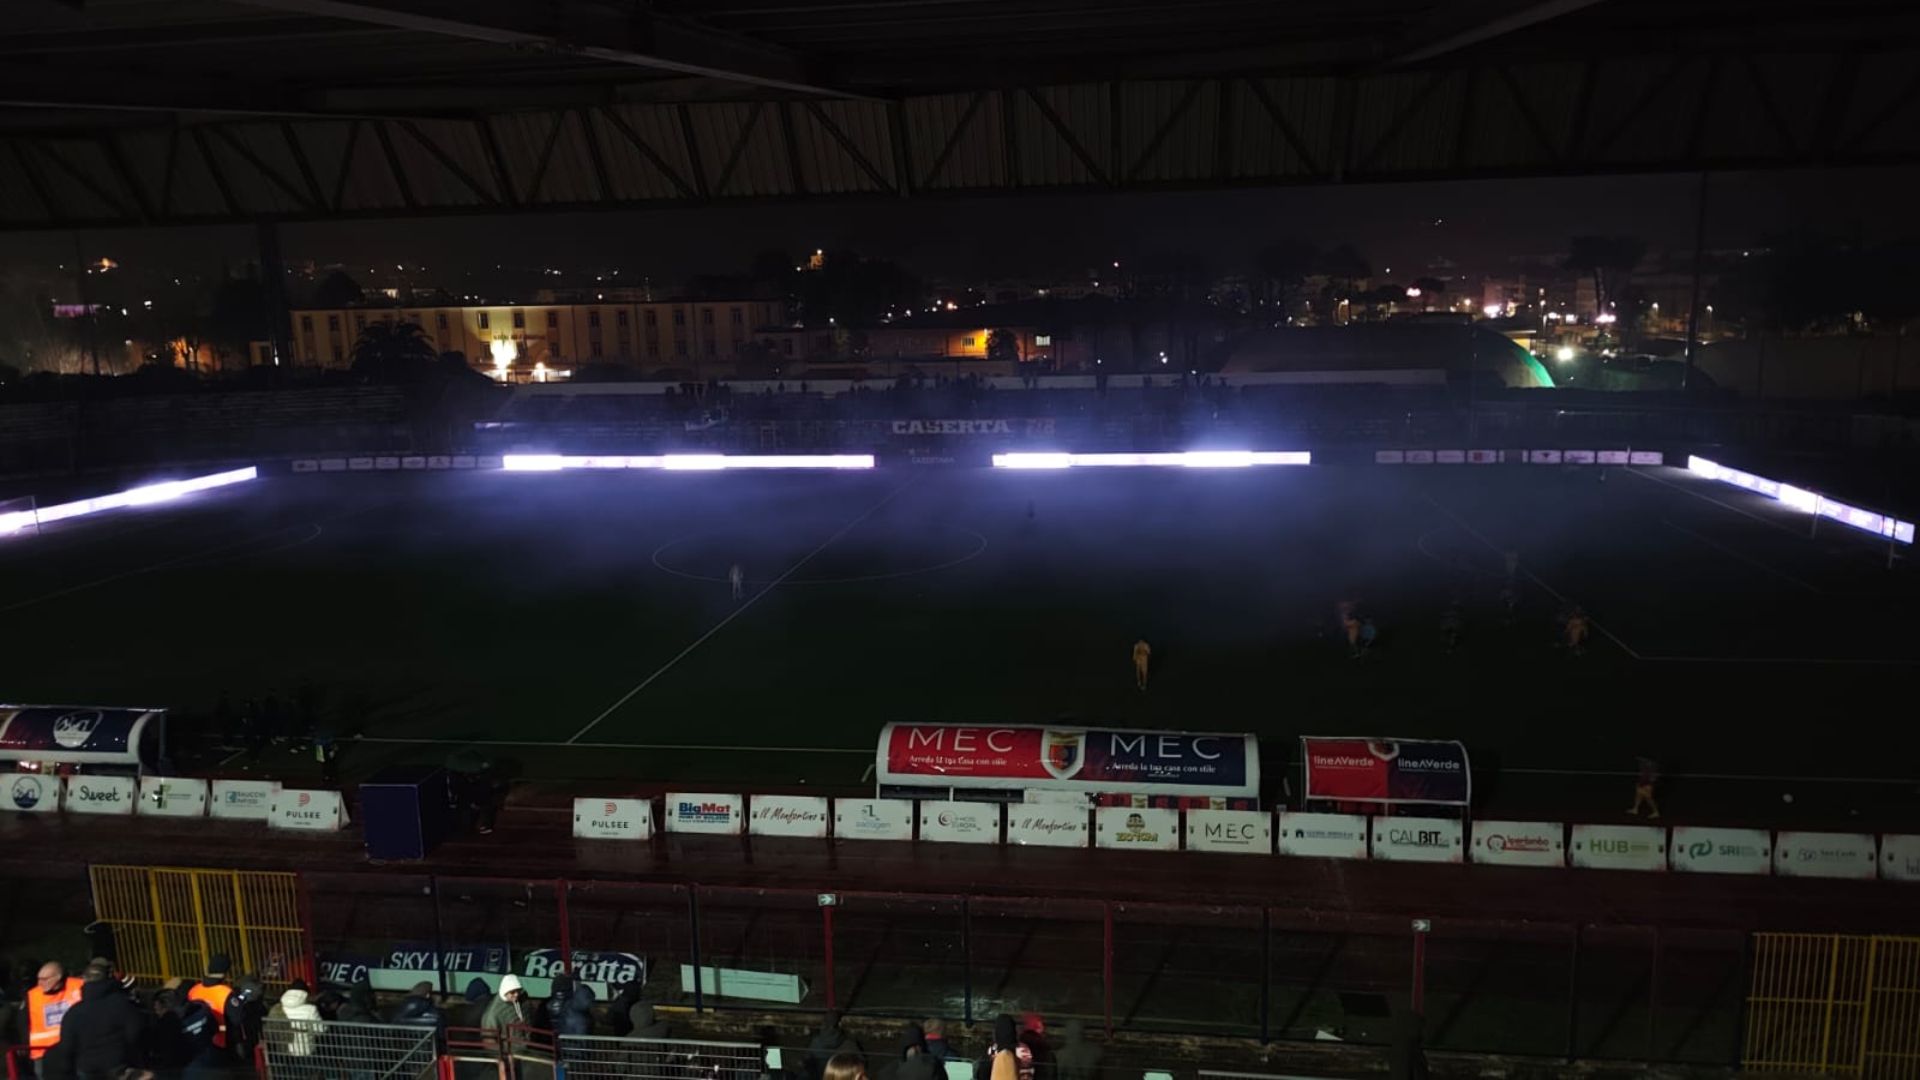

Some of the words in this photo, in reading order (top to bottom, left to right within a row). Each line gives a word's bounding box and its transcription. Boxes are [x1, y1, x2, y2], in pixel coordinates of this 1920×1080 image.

[892, 420, 1012, 434] CASERTA
[909, 728, 1015, 752] MEC
[1111, 734, 1220, 759] MEC
[79, 785, 120, 802] Sweet
[286, 811, 321, 820] PULSEE
[679, 802, 731, 814] BigMat
[592, 820, 629, 829] PULSEE
[1205, 822, 1255, 839] MEC
[1590, 838, 1629, 853] HUB
[389, 951, 430, 970] SKY
[525, 955, 637, 984] Beretta
